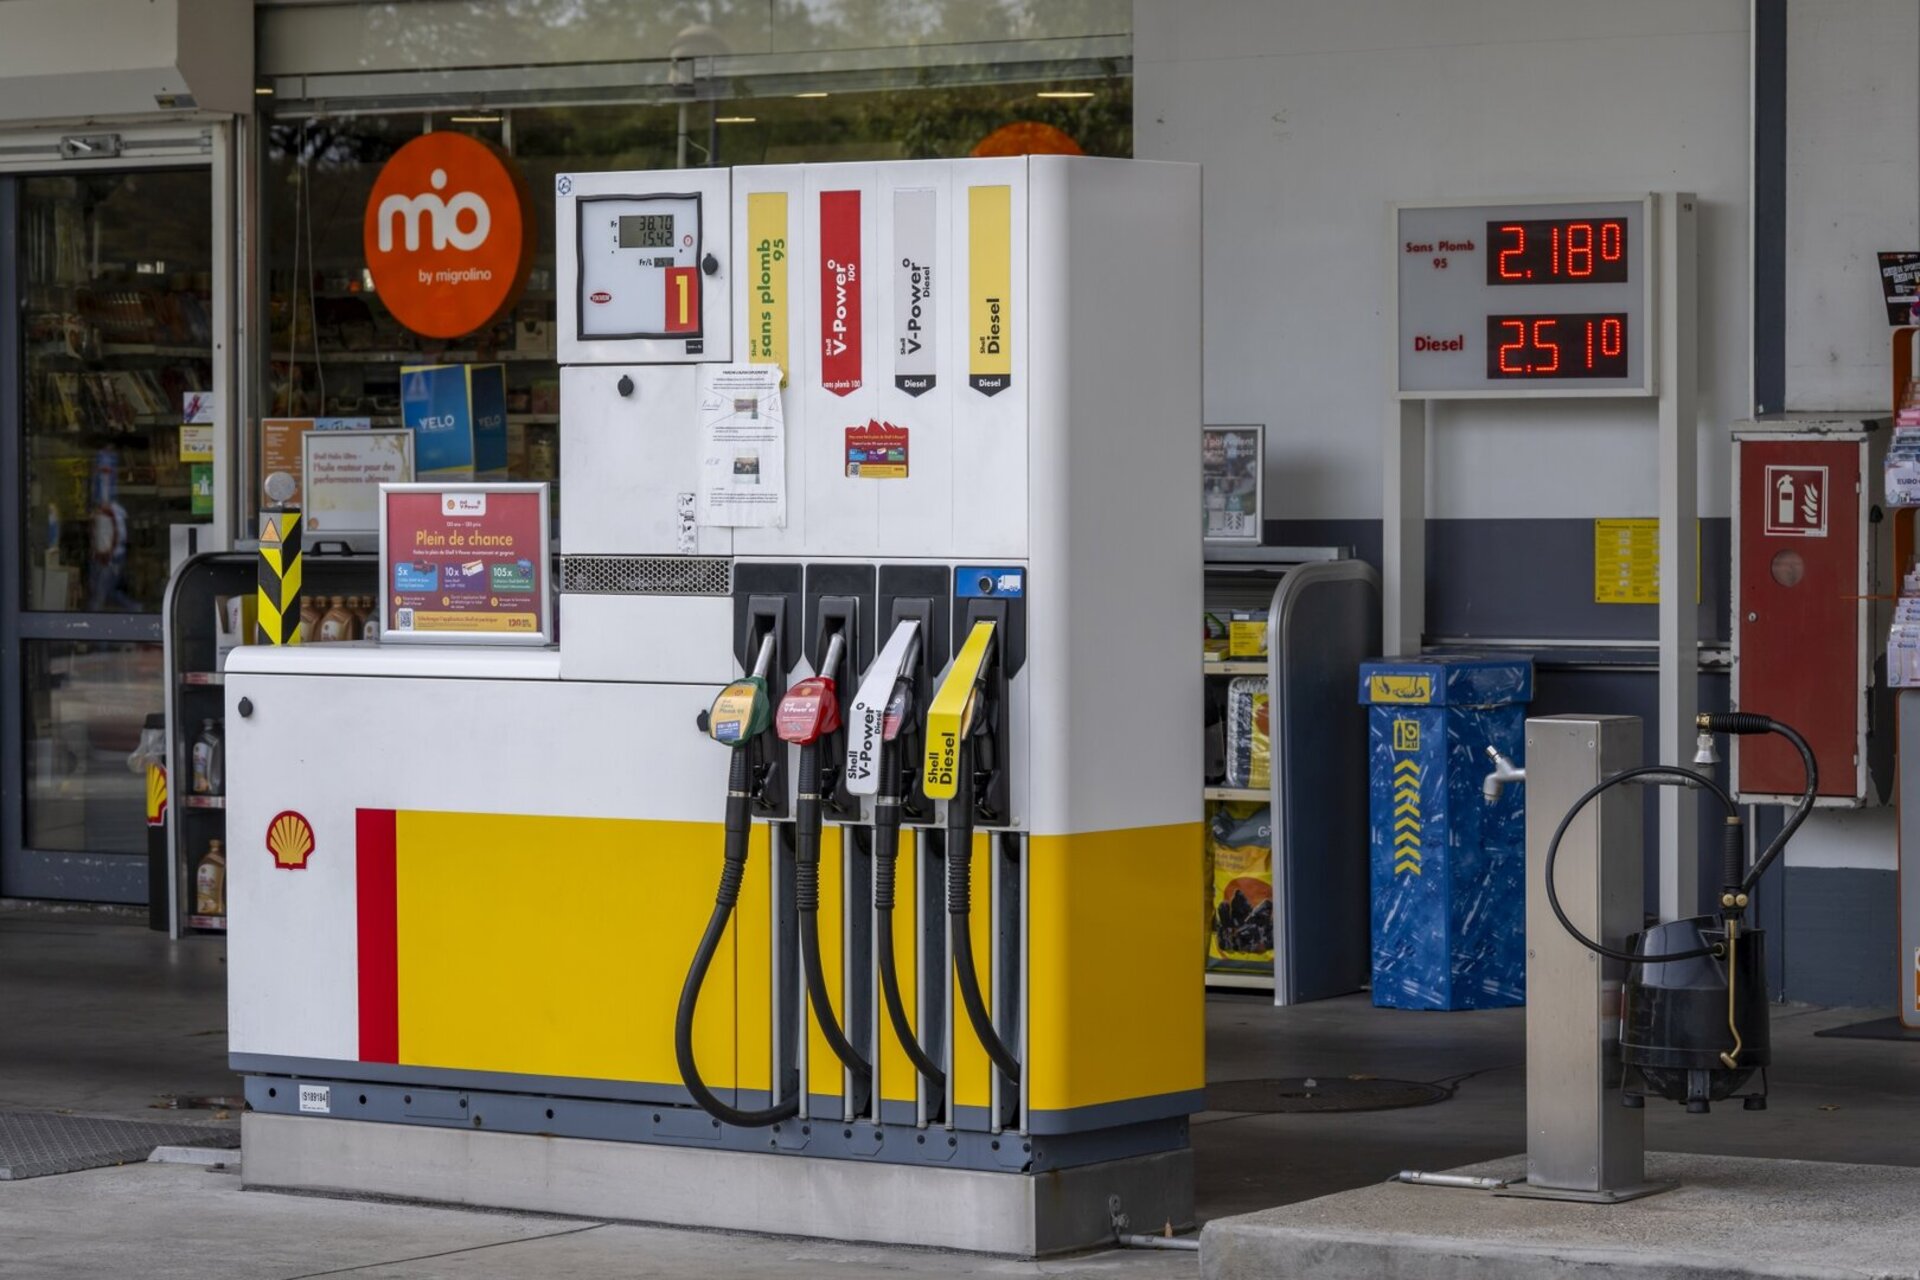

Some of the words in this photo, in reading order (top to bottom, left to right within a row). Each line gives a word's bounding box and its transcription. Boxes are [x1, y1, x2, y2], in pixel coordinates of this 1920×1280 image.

[378, 168, 491, 252] mio
[639, 215, 673, 231] 38.70
[642, 230, 673, 247] 15.42
[1406, 241, 1434, 254] Sans
[1438, 239, 1475, 252] Plomb
[774, 238, 785, 262] 95
[756, 238, 775, 304] plomb
[847, 262, 856, 282] 100
[1433, 257, 1448, 269] 95
[418, 269, 432, 284] by
[436, 267, 491, 285] migrolino
[922, 266, 930, 298] Diesel
[675, 275, 688, 324] 1
[832, 262, 847, 356] V-Power
[907, 261, 922, 355] V-Power
[761, 310, 772, 357] sans
[986, 298, 1000, 355] Diesel
[1414, 334, 1464, 352] Diesel
[835, 379, 850, 390] plomb
[851, 379, 861, 389] 100
[904, 378, 927, 388] Diesel
[978, 378, 1001, 388] Diesel
[418, 414, 455, 430] VELO
[337, 464, 362, 472] moteur
[363, 464, 381, 474] pour
[382, 461, 395, 472] des
[416, 530, 445, 546] Plein
[449, 530, 465, 546] de
[469, 530, 513, 546] chance
[397, 566, 409, 576] 5x
[445, 566, 460, 577] 10x
[493, 567, 513, 577] 105x
[874, 709, 883, 735] Diesel
[858, 706, 875, 780] V-Power
[848, 750, 858, 780] Shell
[927, 752, 940, 784] Shell
[939, 732, 956, 785] Diesel
